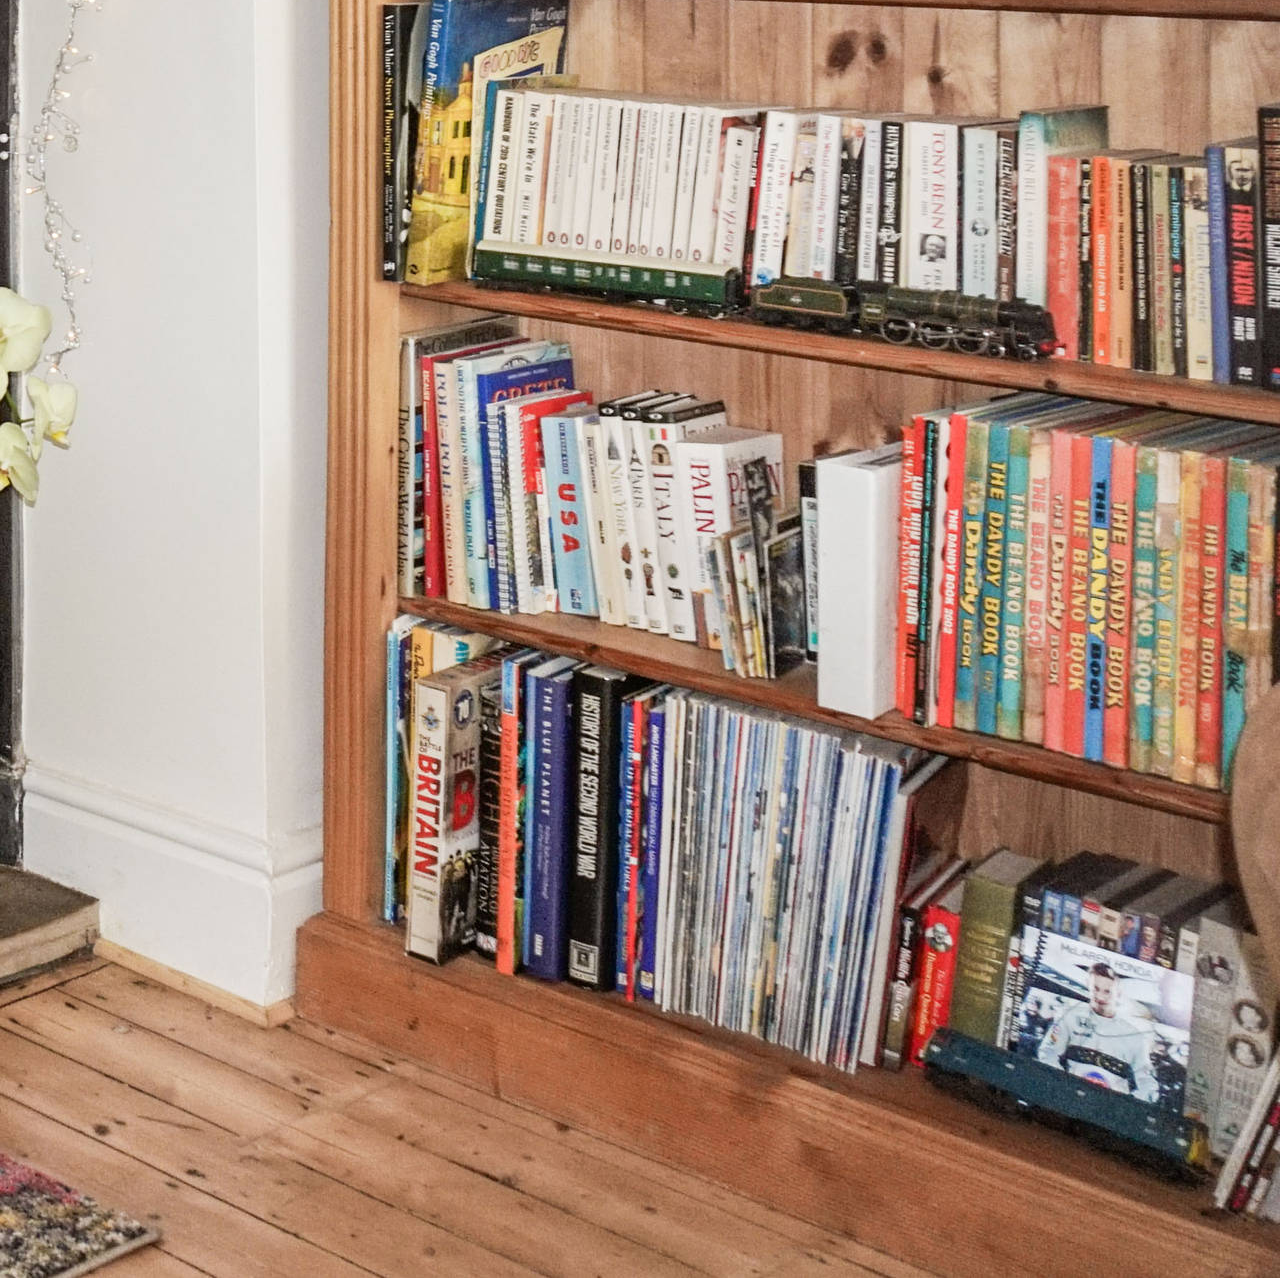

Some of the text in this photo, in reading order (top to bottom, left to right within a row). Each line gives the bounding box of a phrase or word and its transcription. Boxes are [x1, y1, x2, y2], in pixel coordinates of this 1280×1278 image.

[384, 14, 395, 76] Vivian Maier
[423, 17, 443, 121] Van Gogh Paintings
[383, 77, 395, 106] Street
[502, 95, 515, 133] HANDBOOK
[383, 109, 395, 177] Photographer
[497, 162, 509, 191] CENTURY
[499, 143, 510, 160] 20th
[524, 102, 541, 183] The State We're In
[884, 125, 900, 225] HUNTER THOMPSON
[492, 192, 505, 235] QUOTATIONS
[521, 195, 531, 210] Will
[933, 132, 947, 230] TONY BENN
[1171, 201, 1182, 261] hemingway
[1232, 204, 1256, 306] FROST NIXON
[1097, 234, 1107, 313] COMING UP FOR AIR
[398, 405, 410, 433] The
[436, 372, 452, 496] POLE POLE
[398, 434, 410, 491] Collins
[608, 462, 626, 536] NEW YORK
[630, 465, 644, 509] PARIS
[989, 461, 1007, 501] THE
[397, 491, 409, 531] World
[465, 499, 474, 532] MICHAEL
[652, 472, 677, 543] ITALY
[689, 463, 717, 536] PALIN
[1030, 476, 1048, 590] THE BEANO
[945, 508, 959, 604] THE DANDY BOOK
[984, 511, 1005, 587] DANDY
[960, 520, 983, 667] Dandy BOOK
[1003, 492, 1026, 681] THE BEANO BOOK
[1047, 493, 1068, 686] THE Dandy BOOK
[1068, 498, 1089, 692] THE BEANO BOOK
[1088, 479, 1109, 712] THE DANDY BOOK
[1106, 501, 1129, 710] THE DANDY BOOK
[1134, 509, 1154, 707] THE BEANO BOOK
[1181, 565, 1200, 638] BEANO
[1199, 523, 1219, 692] THE DANDY BOOK
[982, 596, 1001, 656] BOOK
[1178, 647, 1197, 708] BOOK
[1225, 649, 1244, 694] Book
[541, 686, 553, 816] THE BLUE PLANET
[577, 692, 601, 879] HISTORY OF THE SECOND WORLD WAR
[413, 753, 442, 877] BRITAIN
[479, 840, 491, 912] AVIATION
